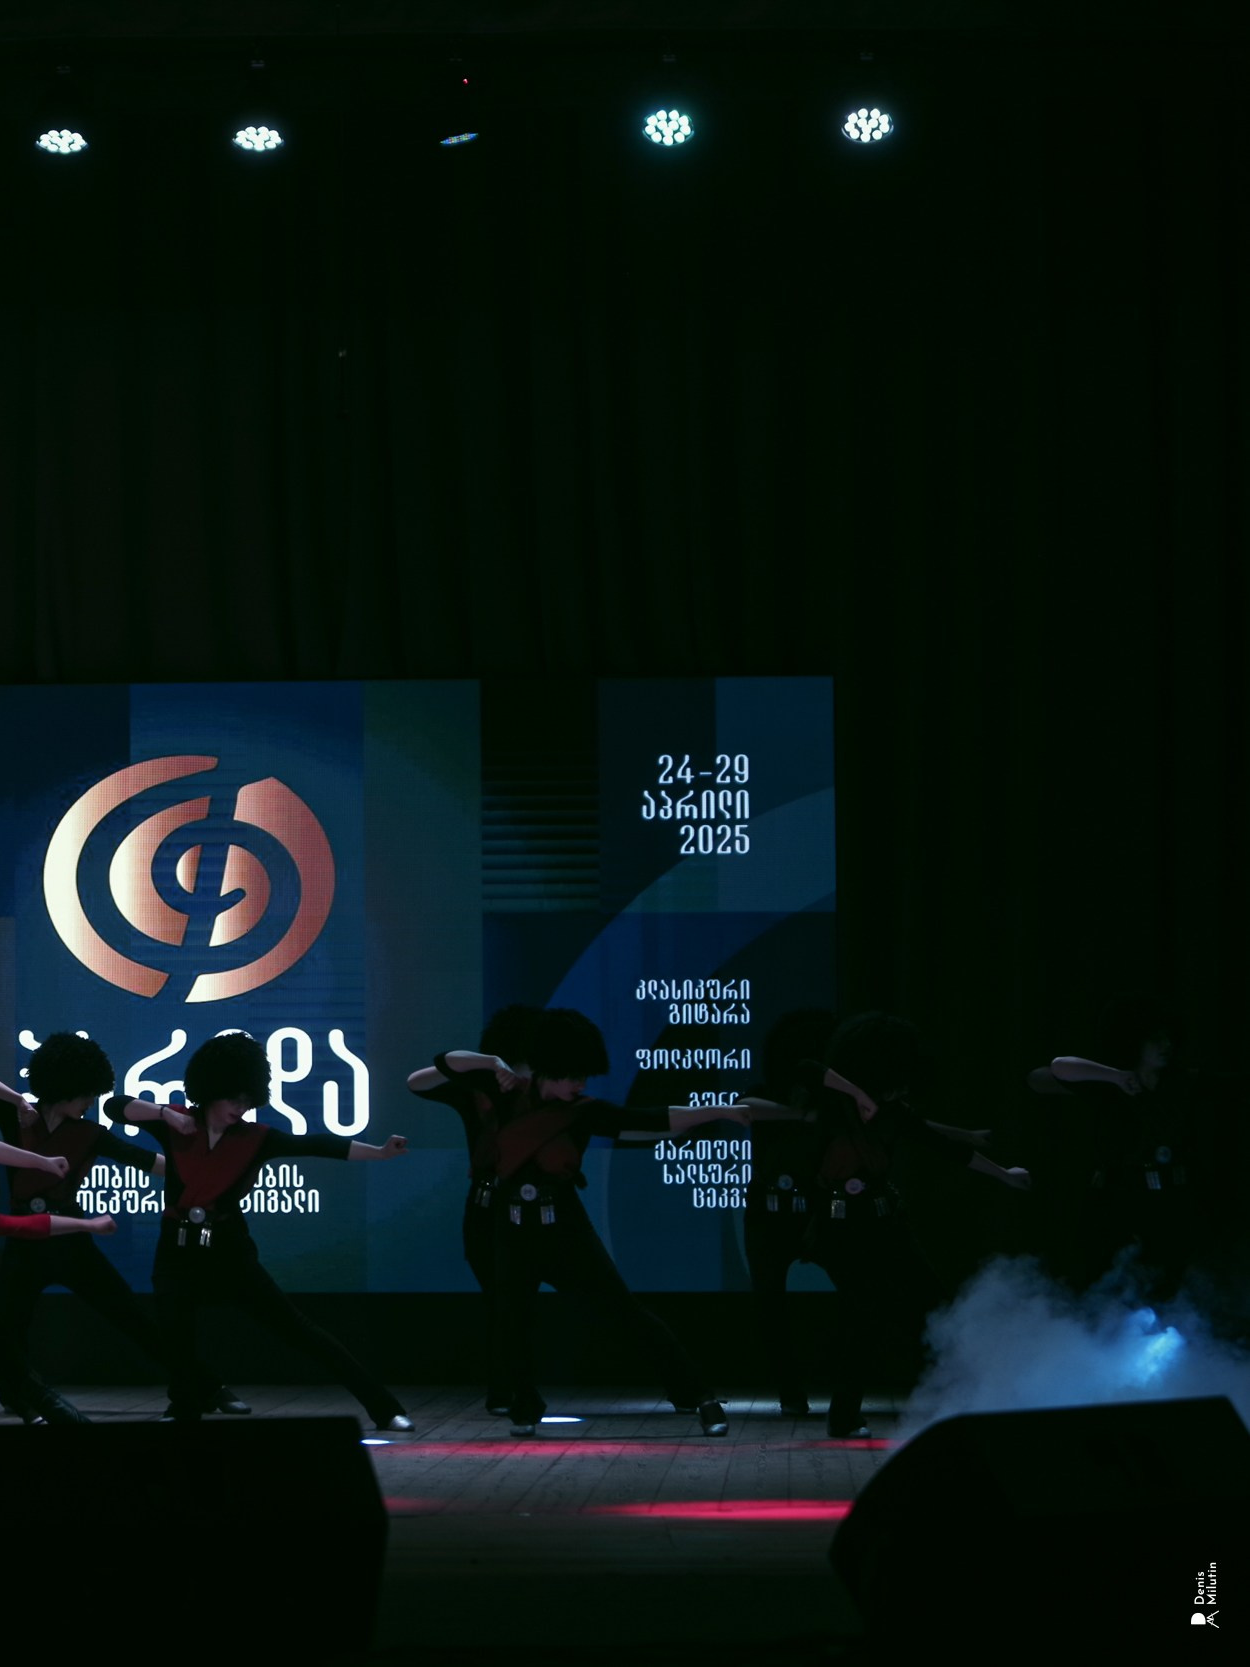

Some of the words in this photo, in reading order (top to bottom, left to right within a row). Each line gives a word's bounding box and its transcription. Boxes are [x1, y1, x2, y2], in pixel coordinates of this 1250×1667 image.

[657, 753, 750, 785] 24-29
[641, 789, 750, 820] აპრილი
[679, 824, 750, 854] 2025
[635, 979, 751, 1001] კლასიკური
[668, 1002, 751, 1025] გიტარა
[635, 1048, 751, 1070] ფოლკლორი
[654, 1139, 751, 1161] ქართული
[663, 1163, 751, 1185] ხალხური
